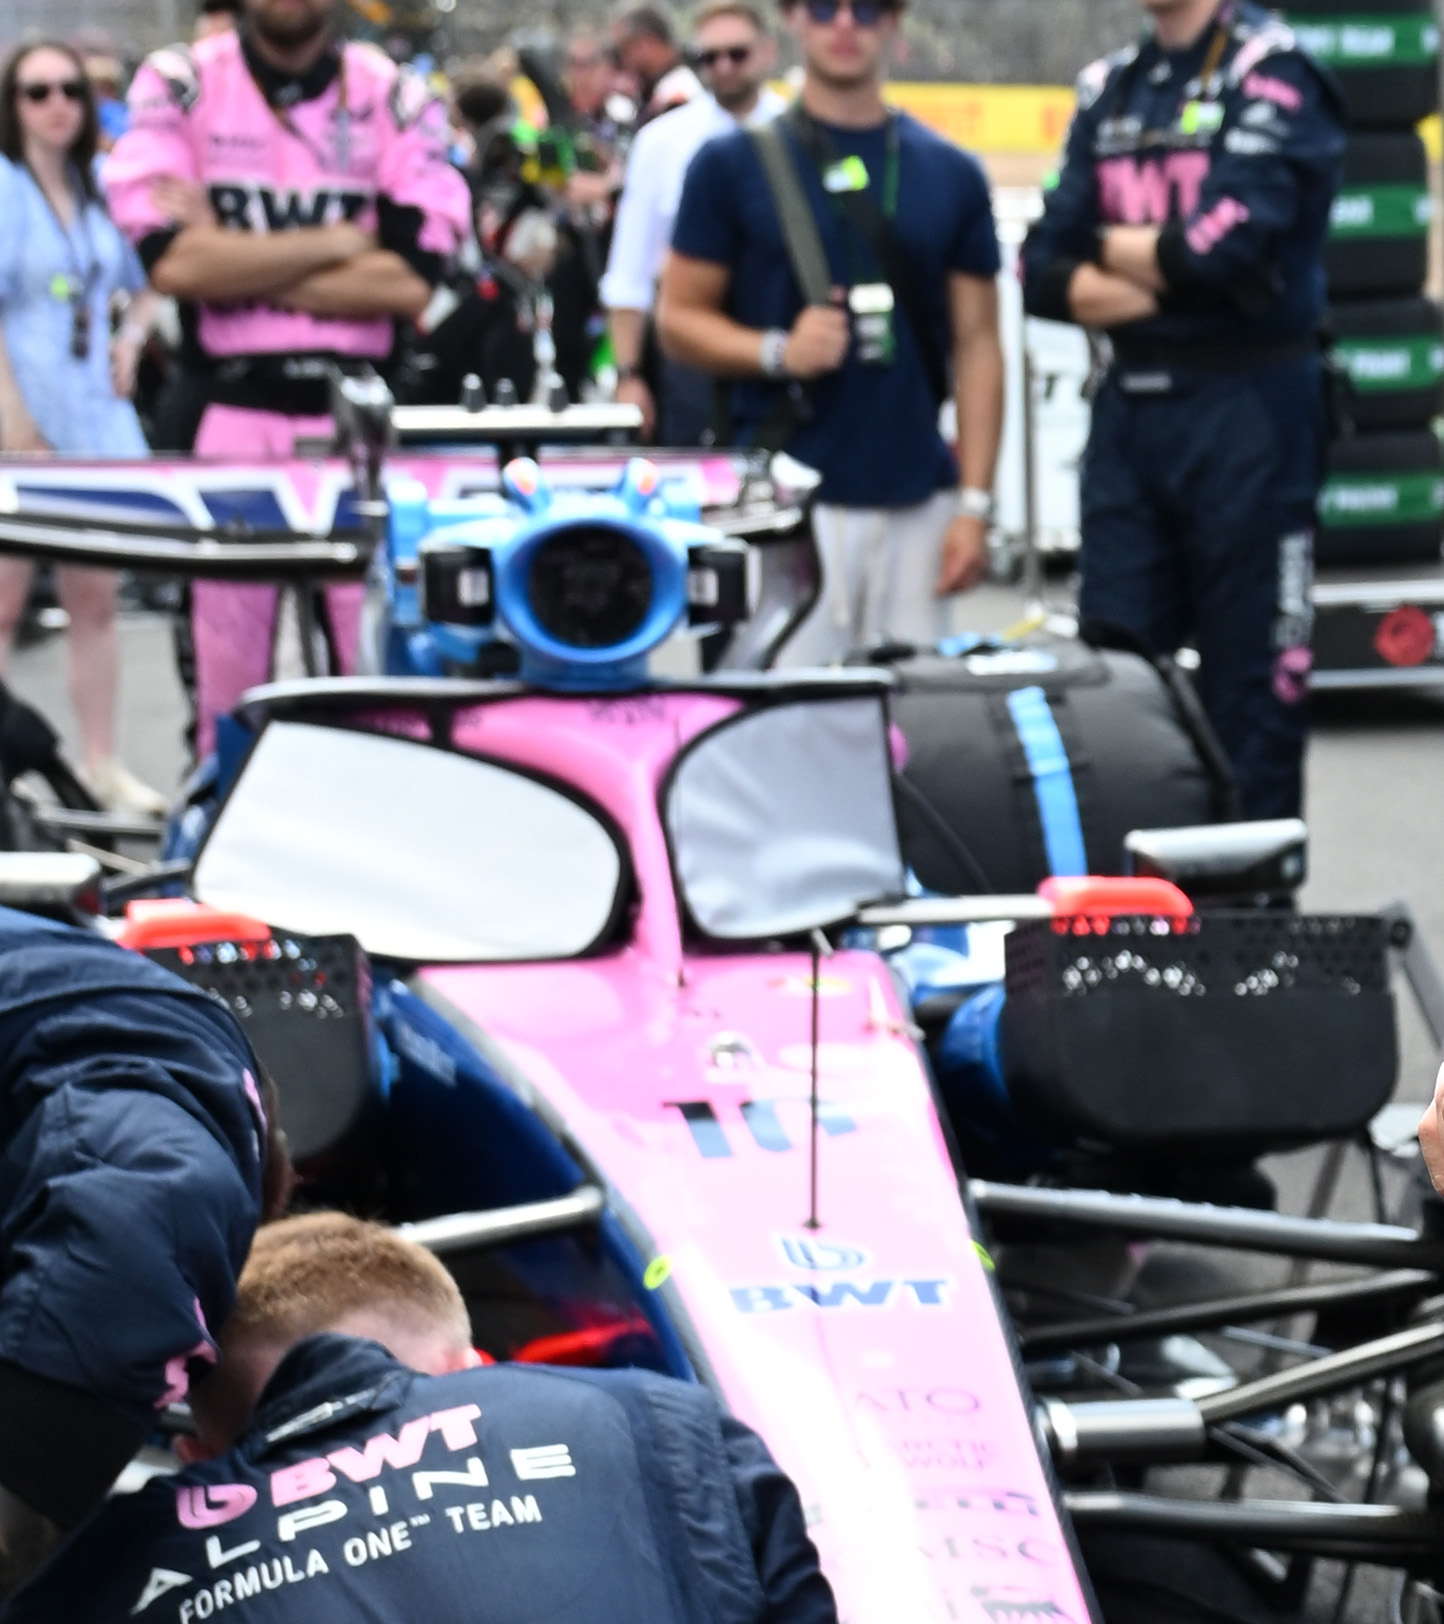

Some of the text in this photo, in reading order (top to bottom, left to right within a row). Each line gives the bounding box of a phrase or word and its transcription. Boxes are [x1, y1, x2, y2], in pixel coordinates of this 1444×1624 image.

[729, 1281, 948, 1314] BWT
[271, 1403, 482, 1508] BWT
[131, 1443, 577, 1616] ALPINE
[445, 1494, 543, 1534] TEAM
